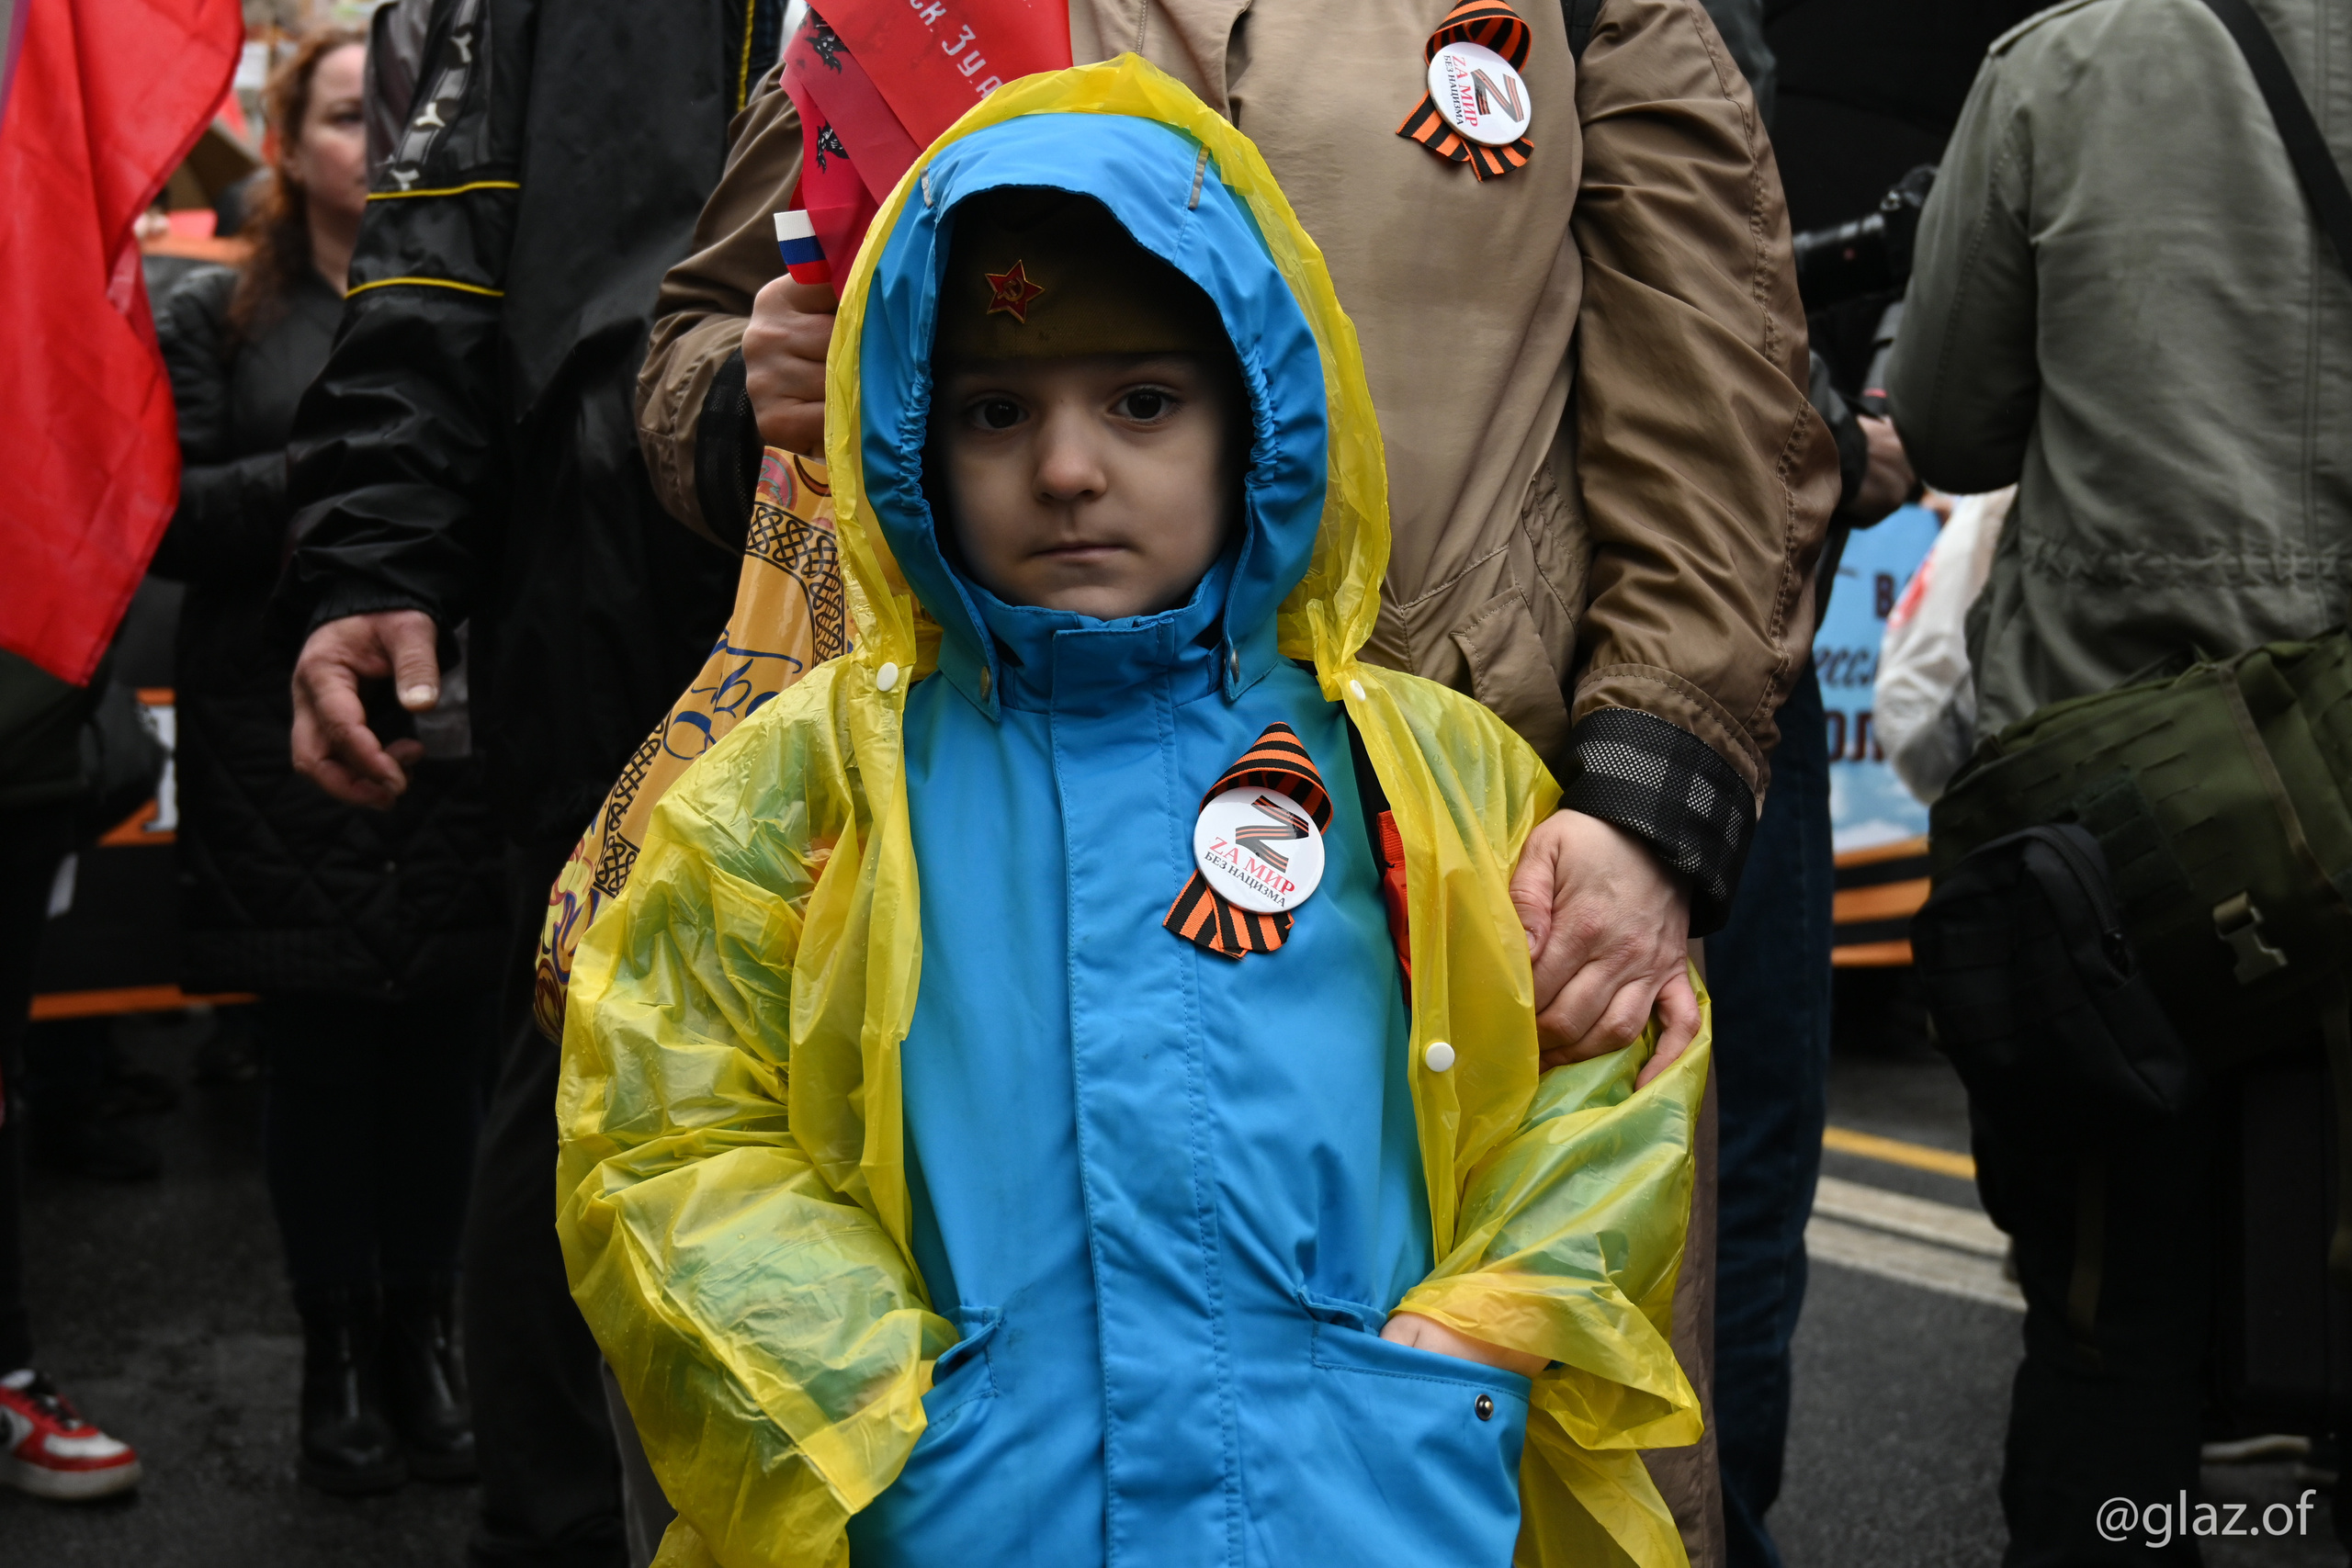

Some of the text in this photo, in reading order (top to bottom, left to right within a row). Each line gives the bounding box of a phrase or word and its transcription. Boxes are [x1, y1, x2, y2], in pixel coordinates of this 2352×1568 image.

[1443, 55, 1464, 126] БЕЗ НАЦИЗМА
[1458, 85, 1478, 128] МИР
[1204, 851, 1286, 908] БЕЗ НАЦИЗМА
[1243, 856, 1295, 896] МИР
